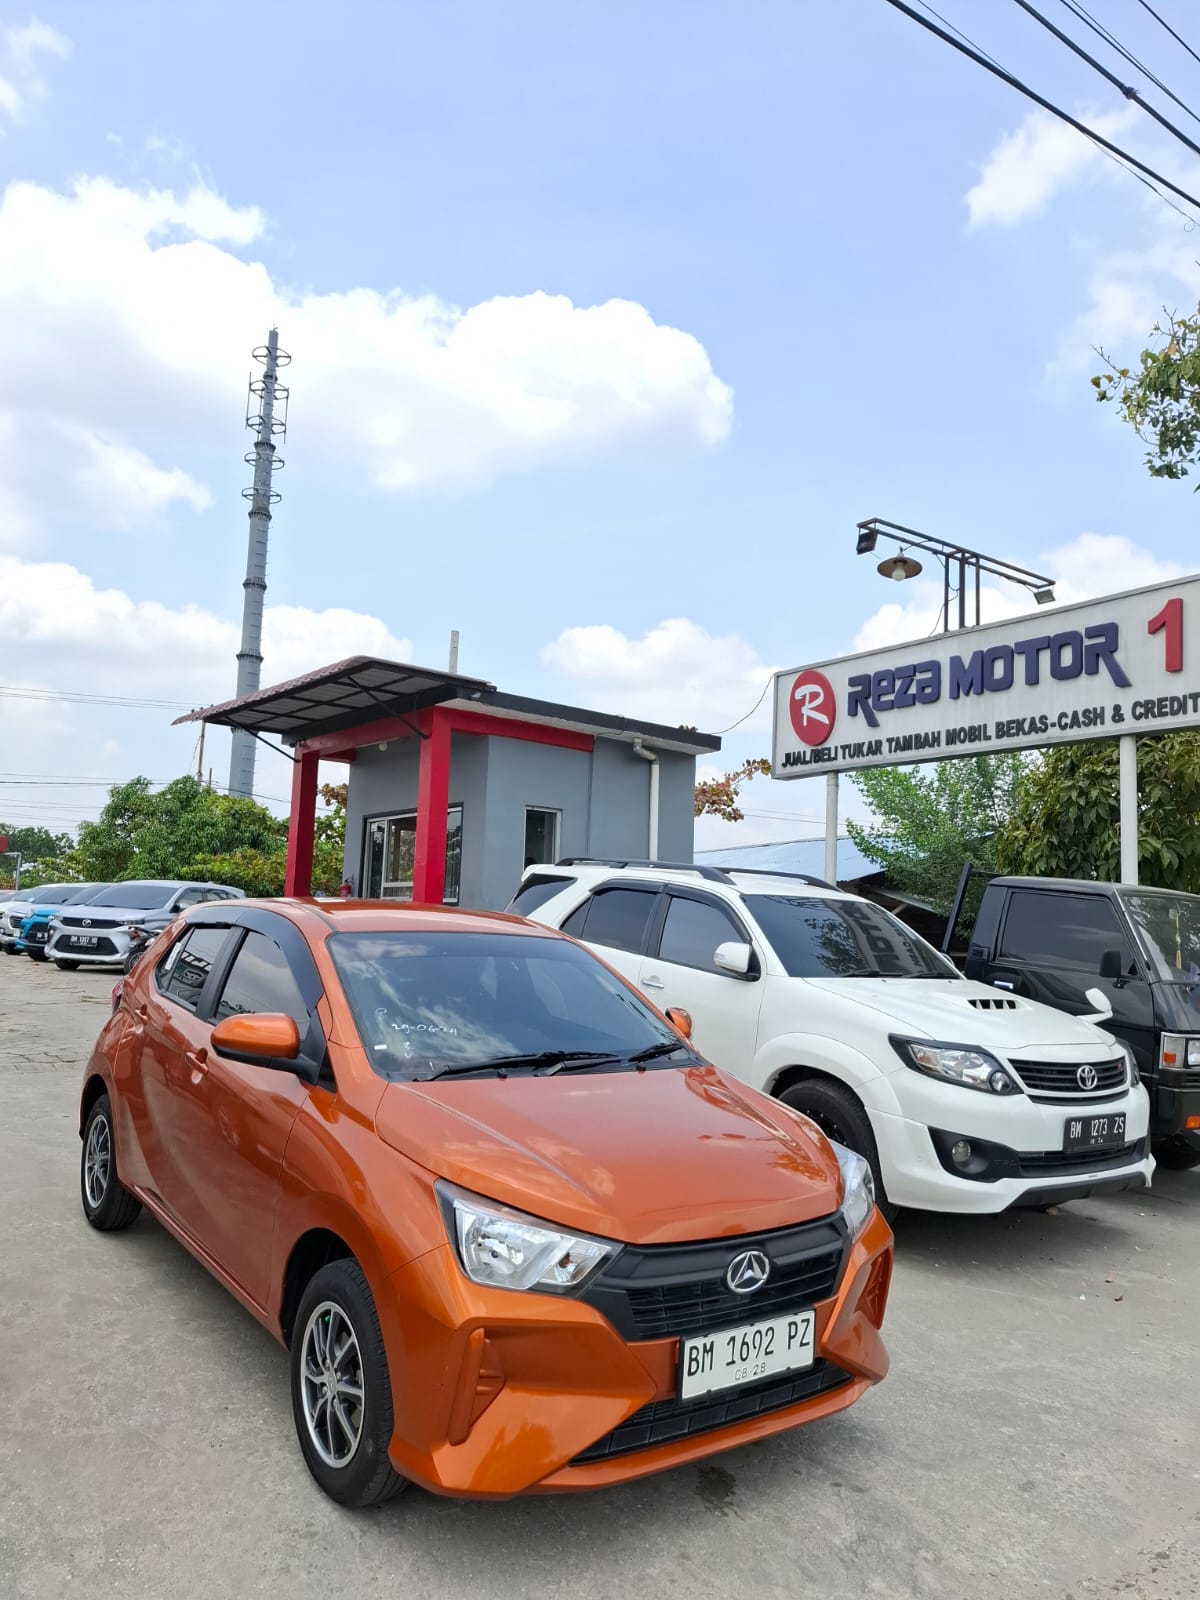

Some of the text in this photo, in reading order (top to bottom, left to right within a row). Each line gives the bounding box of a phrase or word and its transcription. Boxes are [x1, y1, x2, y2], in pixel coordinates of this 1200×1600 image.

[949, 621, 1132, 699] MOTOR
[1147, 597, 1184, 673] 1
[782, 745, 838, 768] JUAL/BELI
[840, 739, 883, 760] TUKAR
[886, 730, 941, 753] TAMBAH
[945, 723, 991, 746] MOBIL
[1111, 703, 1125, 723] &
[1131, 691, 1200, 721] CREDIT
[795, 684, 830, 727] R
[1070, 1116, 1125, 1139] BM 1273 ZS
[687, 1318, 811, 1377] BM 1692 PZ
